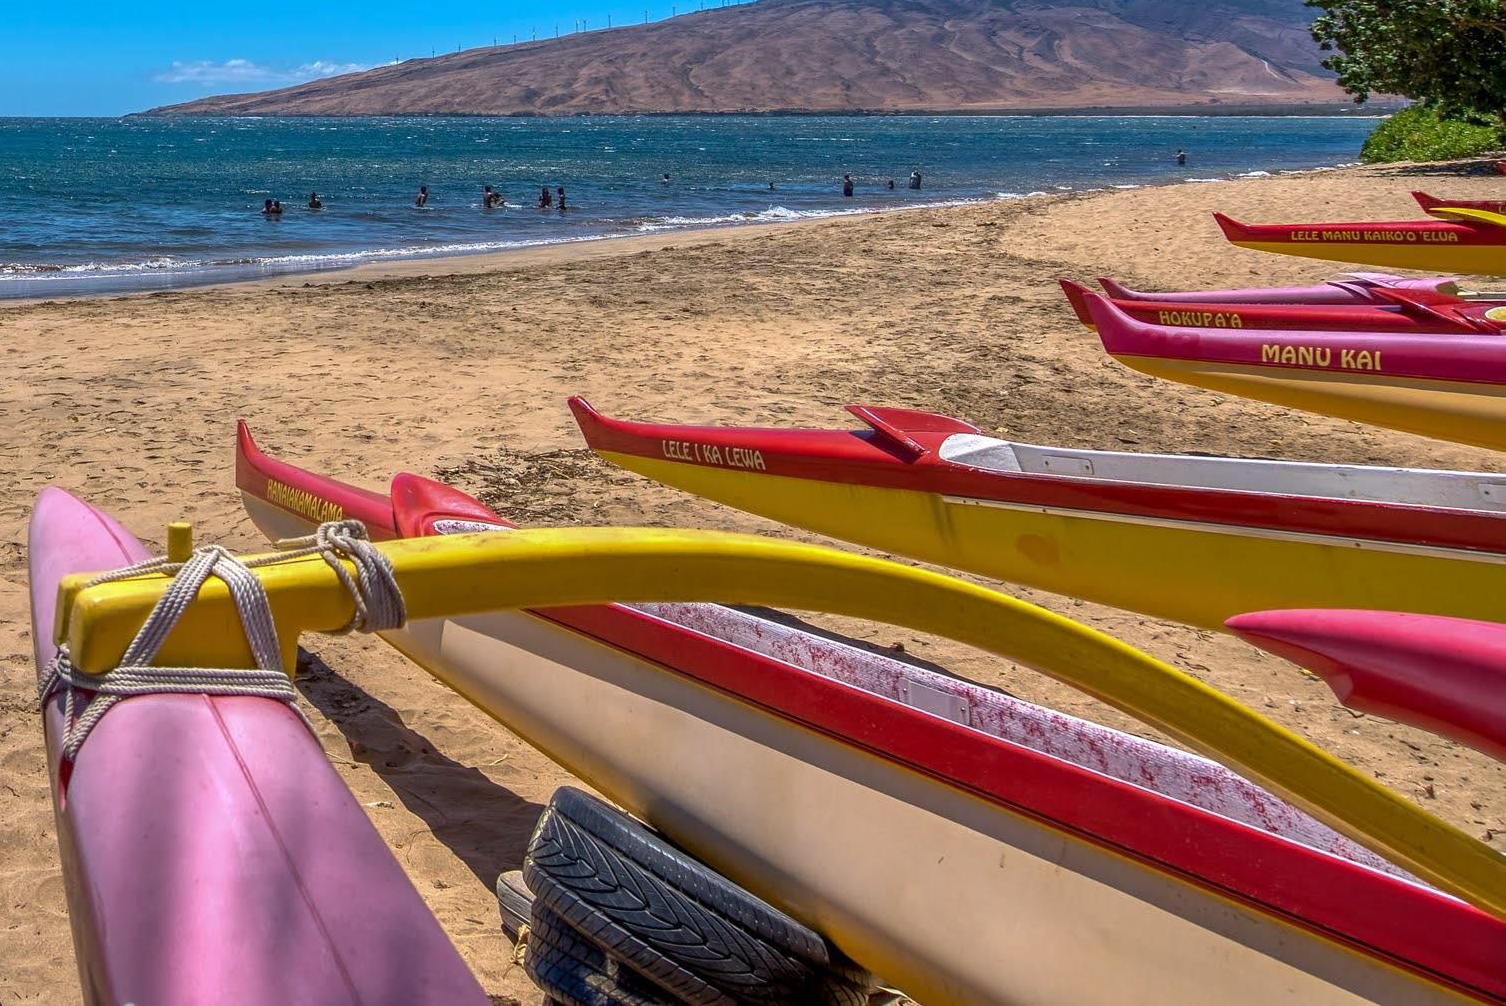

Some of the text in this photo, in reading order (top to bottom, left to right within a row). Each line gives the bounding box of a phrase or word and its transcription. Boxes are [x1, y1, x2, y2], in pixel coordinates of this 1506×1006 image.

[1290, 230, 1320, 241] LELE
[1322, 230, 1361, 241] MANU
[1261, 343, 1382, 371] MANU KAI
[662, 439, 767, 471] LELE I KA LEWA
